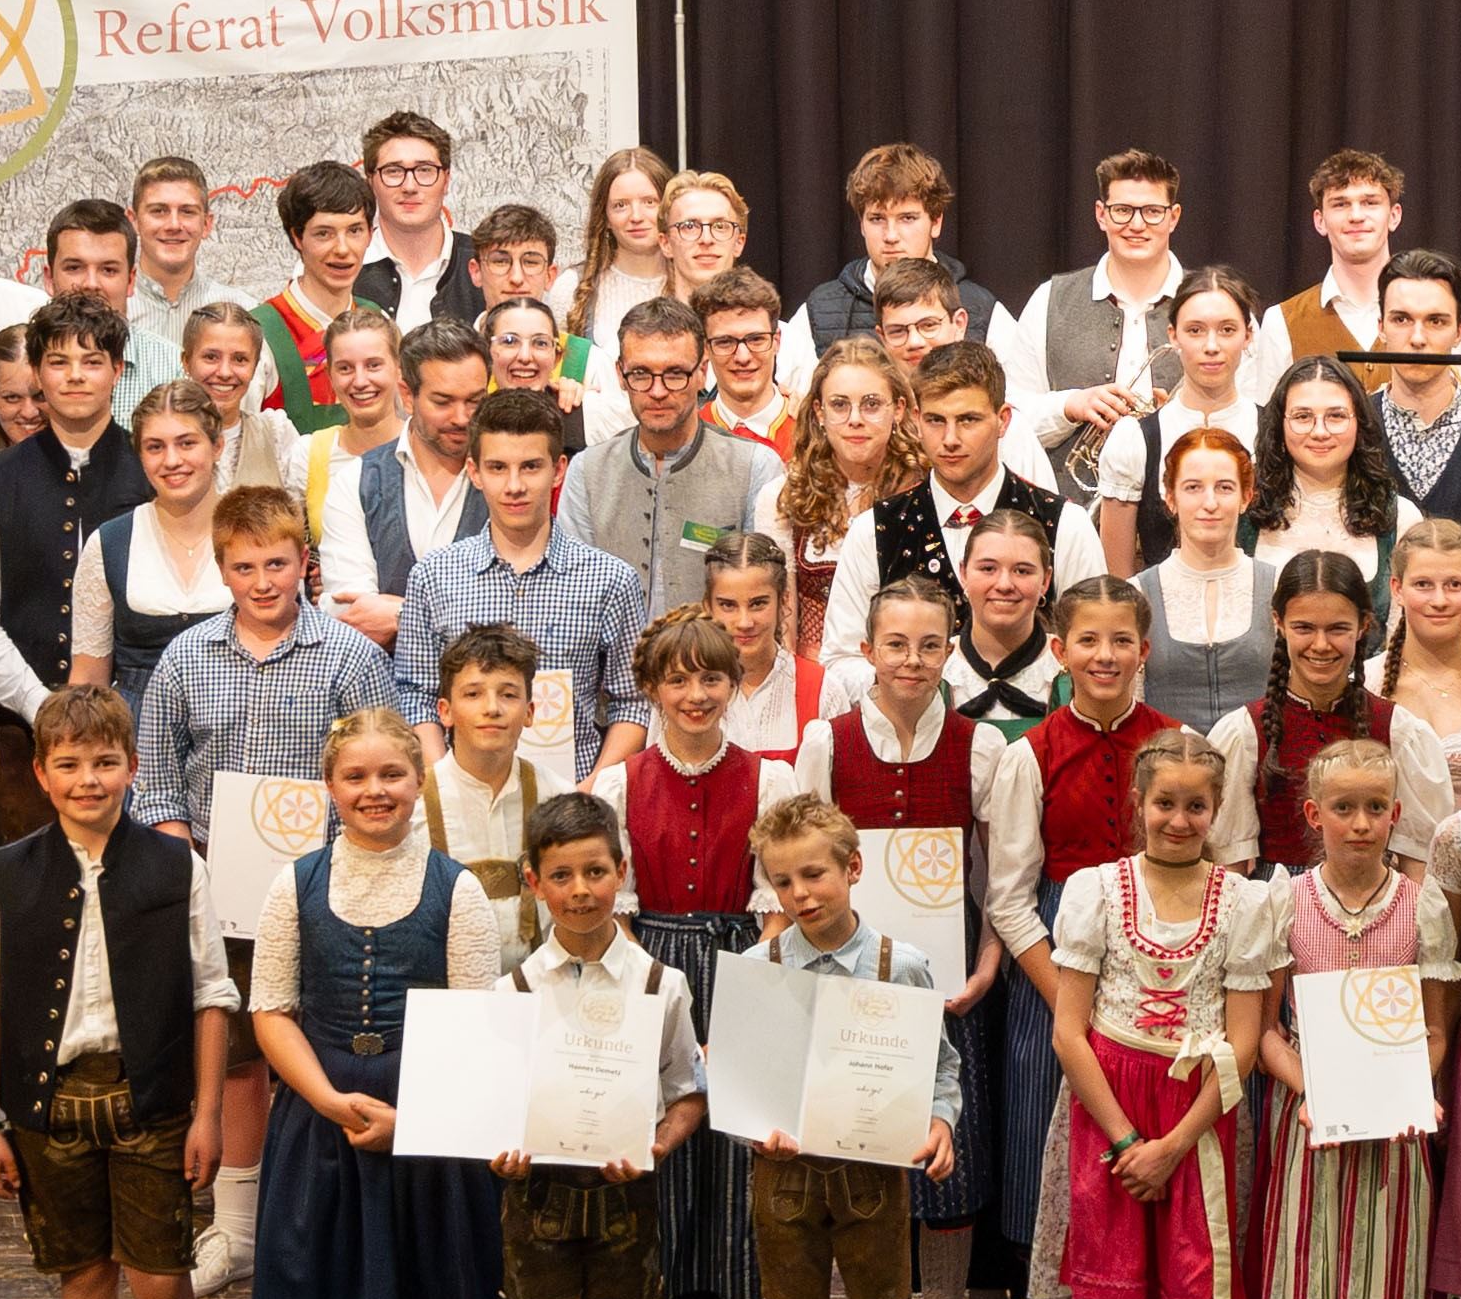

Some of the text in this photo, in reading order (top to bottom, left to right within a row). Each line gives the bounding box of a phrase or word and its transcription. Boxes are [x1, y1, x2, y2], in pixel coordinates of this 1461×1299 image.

[93, 2, 285, 57] Referat
[564, 1032, 634, 1055] Urkunde
[839, 1028, 909, 1050] Urkunde
